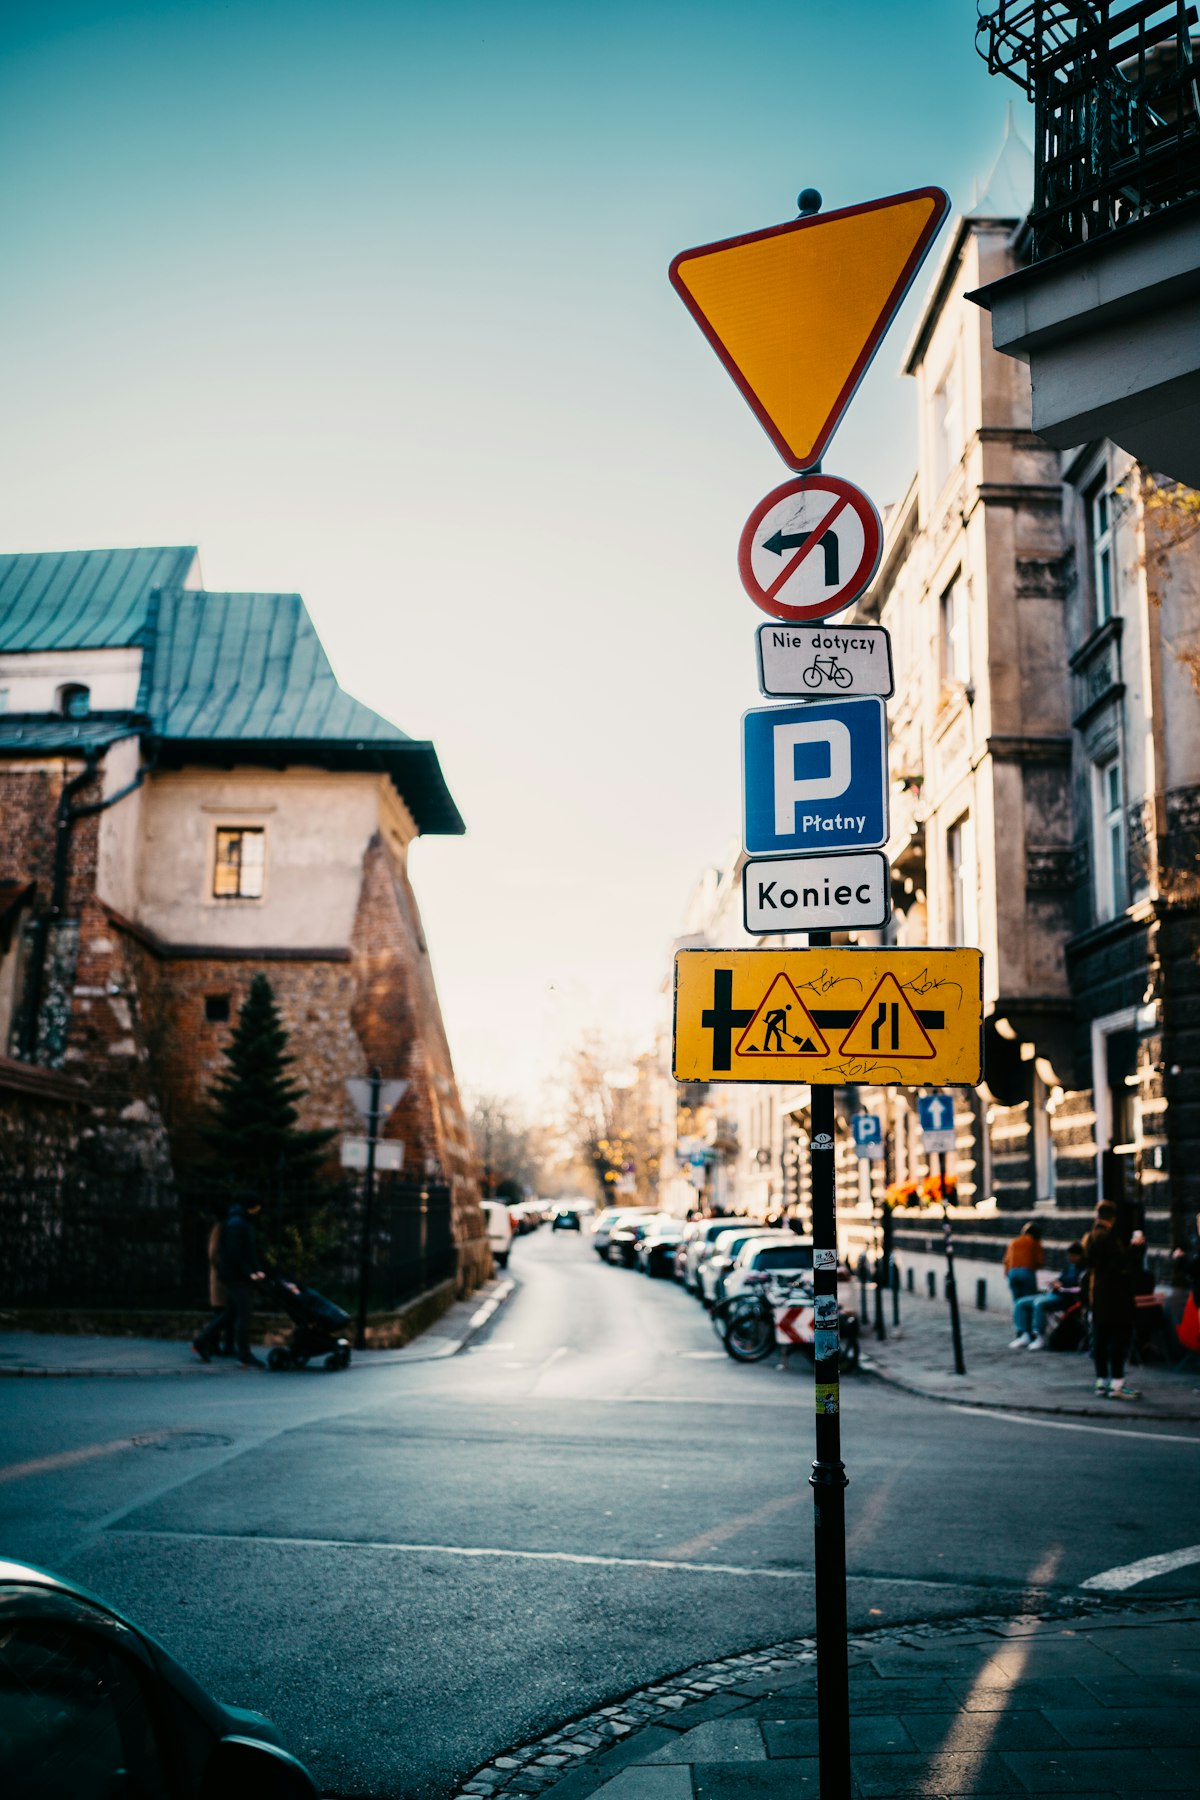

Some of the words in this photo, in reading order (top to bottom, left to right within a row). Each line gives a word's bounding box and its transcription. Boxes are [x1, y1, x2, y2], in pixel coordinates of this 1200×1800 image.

[773, 633, 801, 648] Nie
[812, 633, 875, 654] dotyczy
[773, 719, 851, 836] P
[802, 814, 866, 833] Płatny
[758, 878, 872, 910] Koniec
[858, 1118, 876, 1140] P
